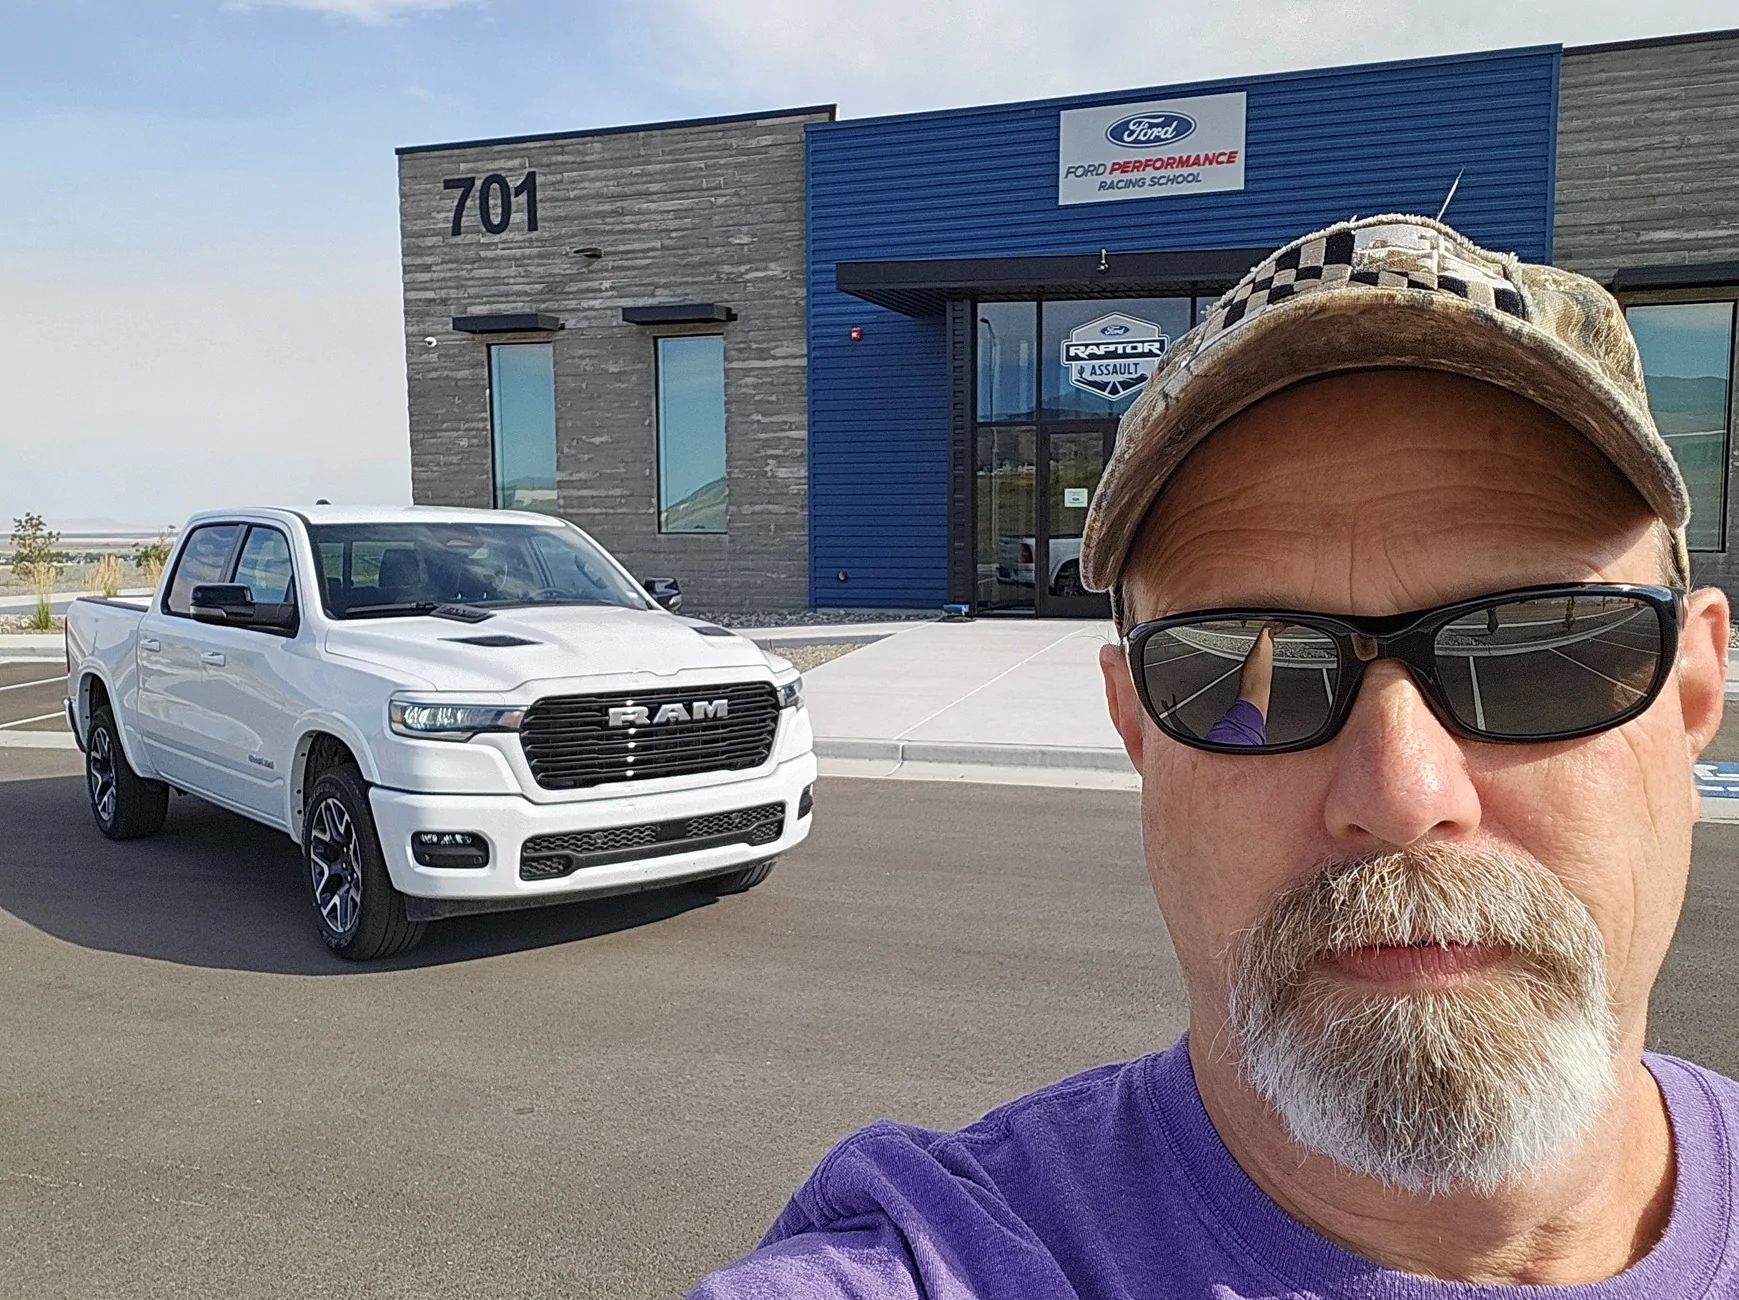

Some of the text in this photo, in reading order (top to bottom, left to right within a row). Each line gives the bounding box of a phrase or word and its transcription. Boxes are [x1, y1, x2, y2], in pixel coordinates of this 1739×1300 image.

[1123, 117, 1178, 142] Ford
[1064, 151, 1238, 179] FORD PERFORMANCE
[1097, 172, 1203, 191] RACING SCHOOL
[443, 170, 538, 236] 701
[1104, 326, 1125, 335] Ford
[1069, 342, 1163, 359] RAPTOR
[1089, 362, 1140, 377] ASSAULT
[608, 699, 729, 727] RAM
